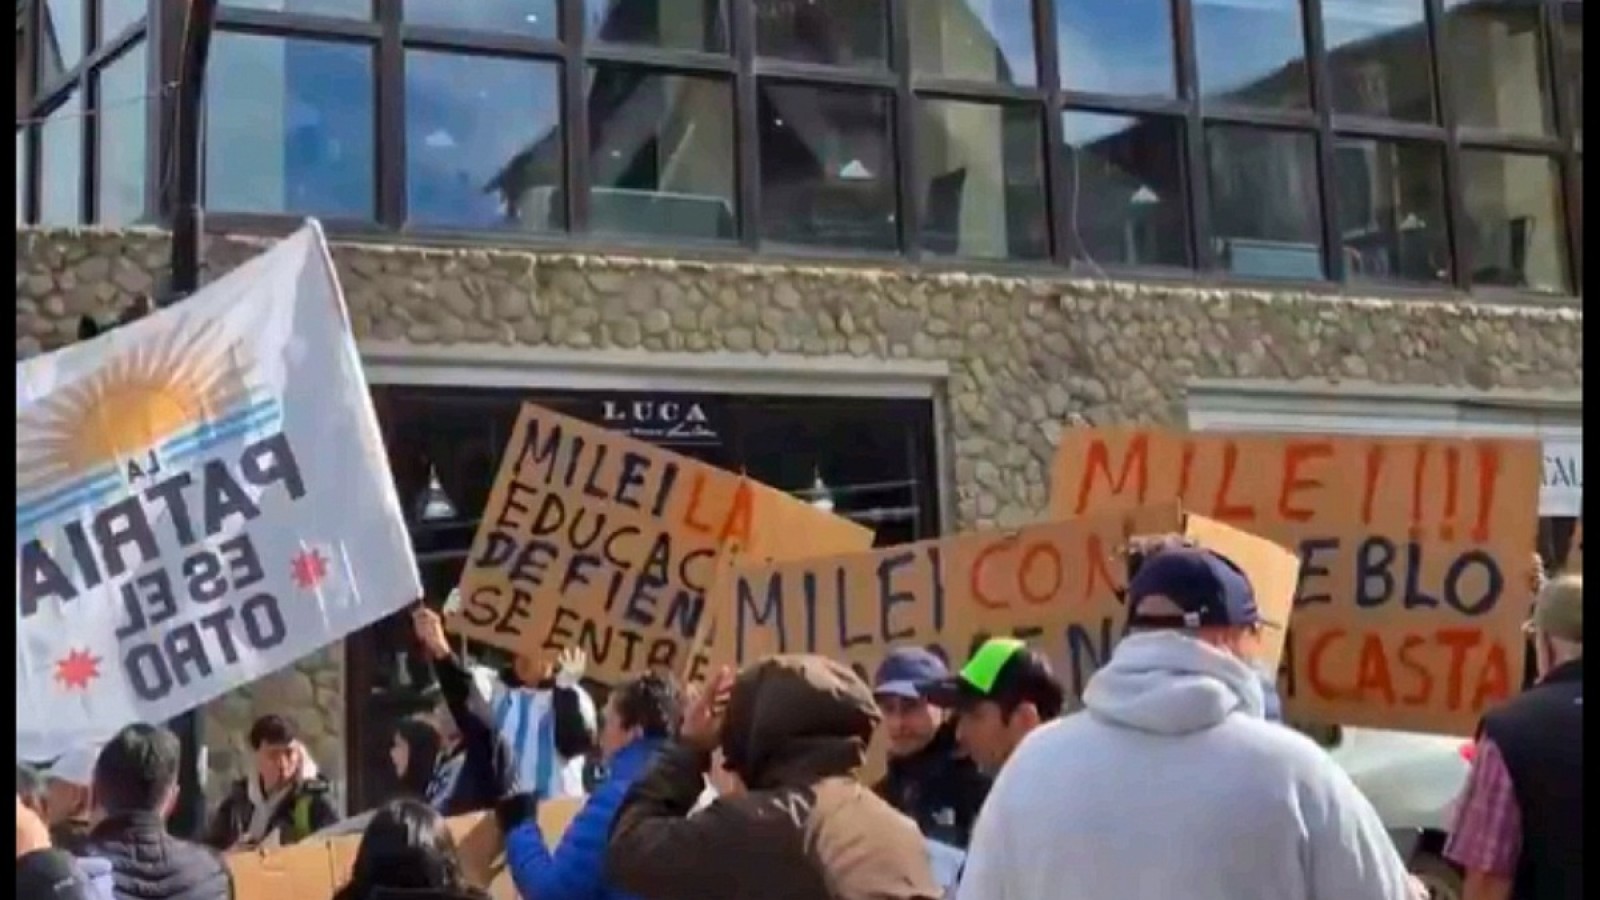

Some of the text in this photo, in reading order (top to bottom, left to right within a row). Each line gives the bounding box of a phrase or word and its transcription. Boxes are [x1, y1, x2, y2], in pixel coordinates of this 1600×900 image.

[603, 401, 707, 421] LUCA
[515, 418, 757, 550] MILEI LA
[497, 481, 716, 592] EDUCAC
[1292, 535, 1504, 616] EBLO
[463, 586, 532, 636] SE
[475, 532, 705, 640] DEFIEN
[734, 547, 945, 664] MILEI
[1307, 627, 1510, 713] CASTA
